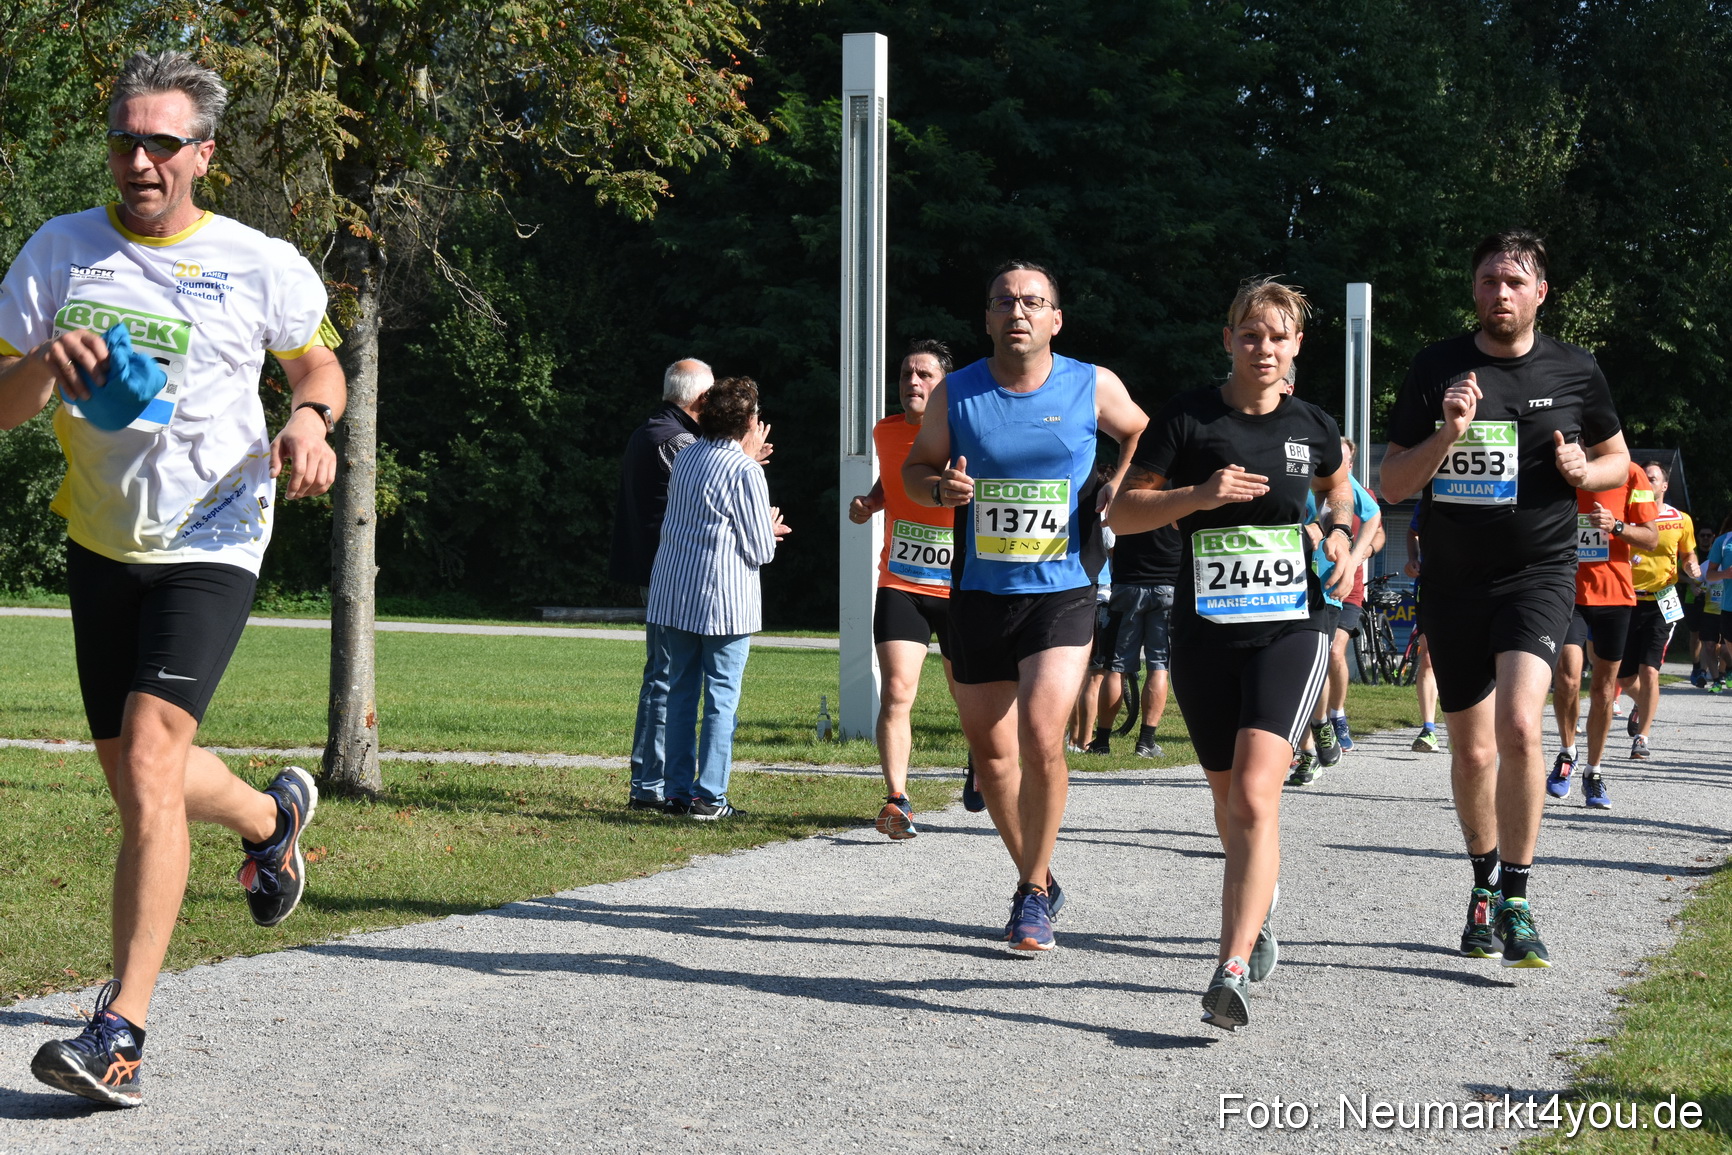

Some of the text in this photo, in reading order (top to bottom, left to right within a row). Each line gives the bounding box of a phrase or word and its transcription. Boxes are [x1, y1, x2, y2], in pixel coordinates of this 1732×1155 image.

[70, 264, 115, 278] BOCK
[175, 263, 200, 277] 20
[64, 303, 181, 350] BOCK
[1437, 451, 1506, 476] 2653
[982, 482, 1062, 501] BOCK
[1447, 483, 1495, 495] JULIAN
[986, 508, 1058, 533] 1374
[1658, 523, 1684, 531] BÖGL
[897, 523, 954, 543] BOCK
[1202, 530, 1294, 553] BOCK
[897, 541, 951, 566] 2700
[998, 538, 1042, 554] JENS
[1207, 559, 1294, 590] 2449
[1207, 595, 1297, 609] MARIE-CLAIRE
